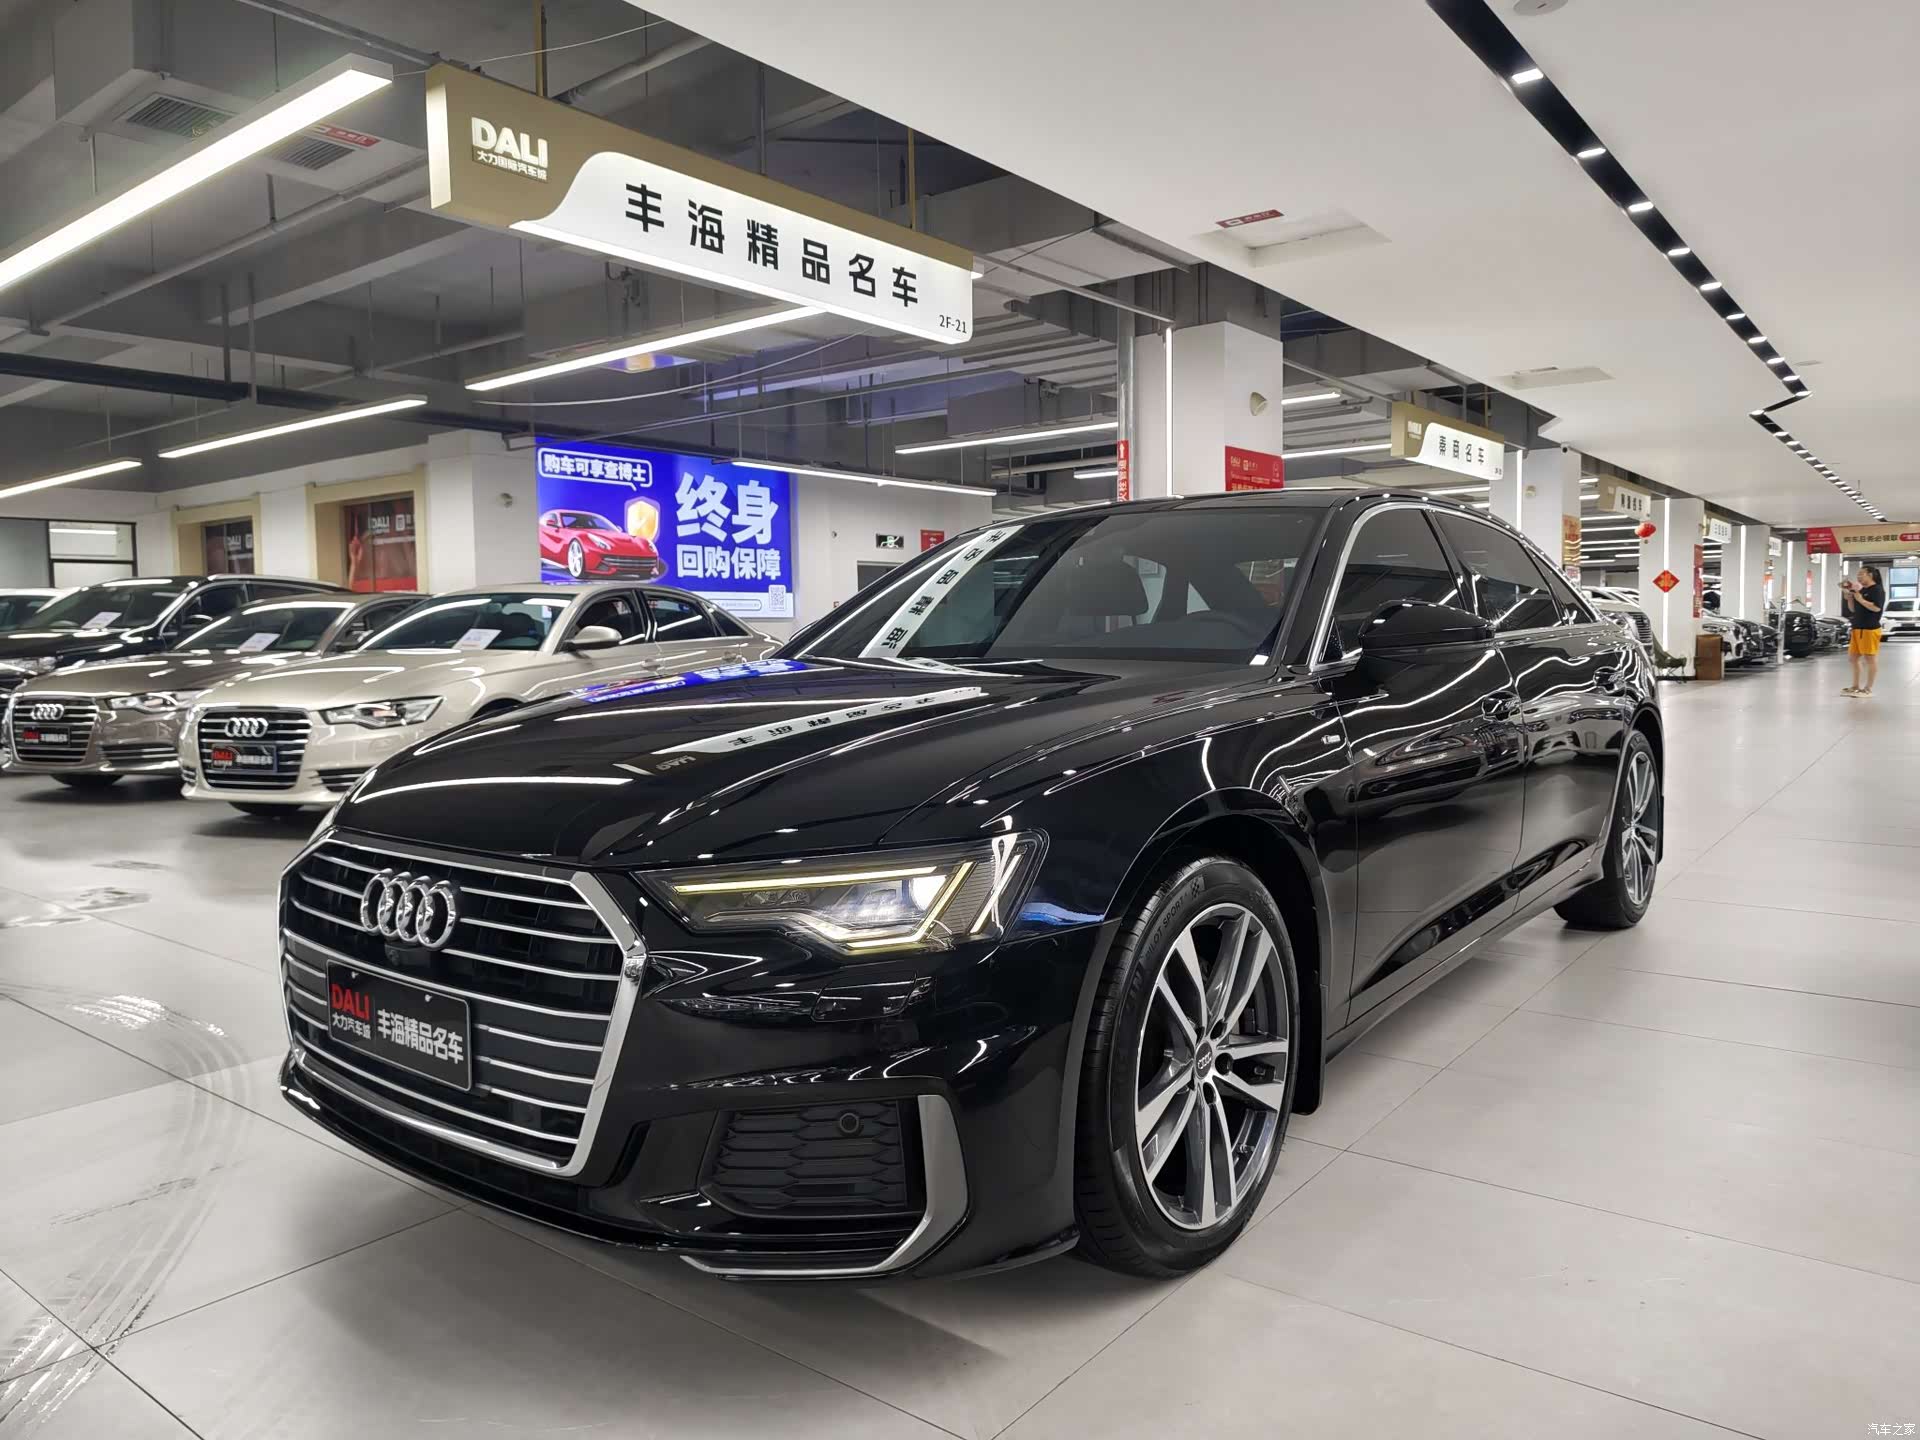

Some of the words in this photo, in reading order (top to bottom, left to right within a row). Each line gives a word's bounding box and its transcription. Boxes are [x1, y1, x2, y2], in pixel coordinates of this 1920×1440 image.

[472, 117, 547, 168] DALI
[626, 184, 918, 307] 丰海精品名车
[939, 315, 967, 334] 2F-21
[544, 453, 647, 482] 购车可享查博士
[675, 472, 779, 545] 终身
[676, 544, 781, 580] 回购保障
[1163, 897, 1184, 927] SPORT
[331, 984, 369, 1020] DALI
[377, 1008, 464, 1065] 丰海精品名车
